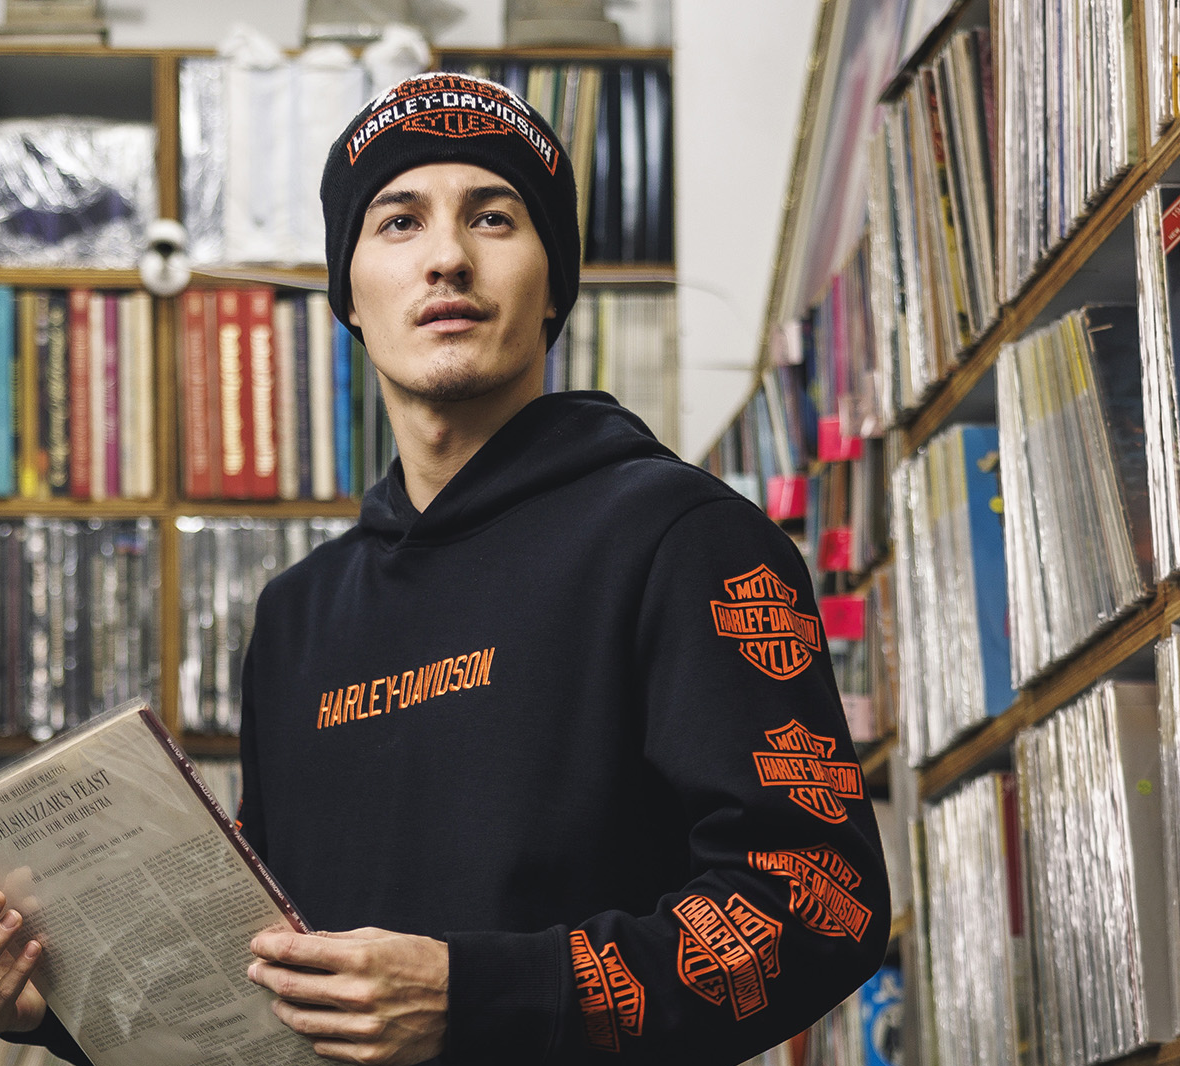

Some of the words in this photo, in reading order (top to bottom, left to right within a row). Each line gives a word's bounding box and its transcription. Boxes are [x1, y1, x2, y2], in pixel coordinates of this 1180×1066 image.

[353, 92, 552, 163] HARLEY-DAVIDSON
[746, 640, 810, 674] CYCLES
[166, 737, 184, 760] WALTON
[0, 794, 12, 805] SIR
[10, 778, 39, 799] WILLIAM
[36, 764, 67, 785] WALTON
[71, 769, 111, 800] FEAST
[13, 829, 47, 852] PARTITA
[45, 819, 65, 836] FOR
[62, 795, 113, 827] ORCHESTRA
[755, 852, 866, 934] HARLEY-DAVIDSON
[681, 897, 762, 1014] HARLEY-DAVIDSON
[728, 905, 775, 974] MOTOR
[603, 956, 639, 1028] MOTOR
